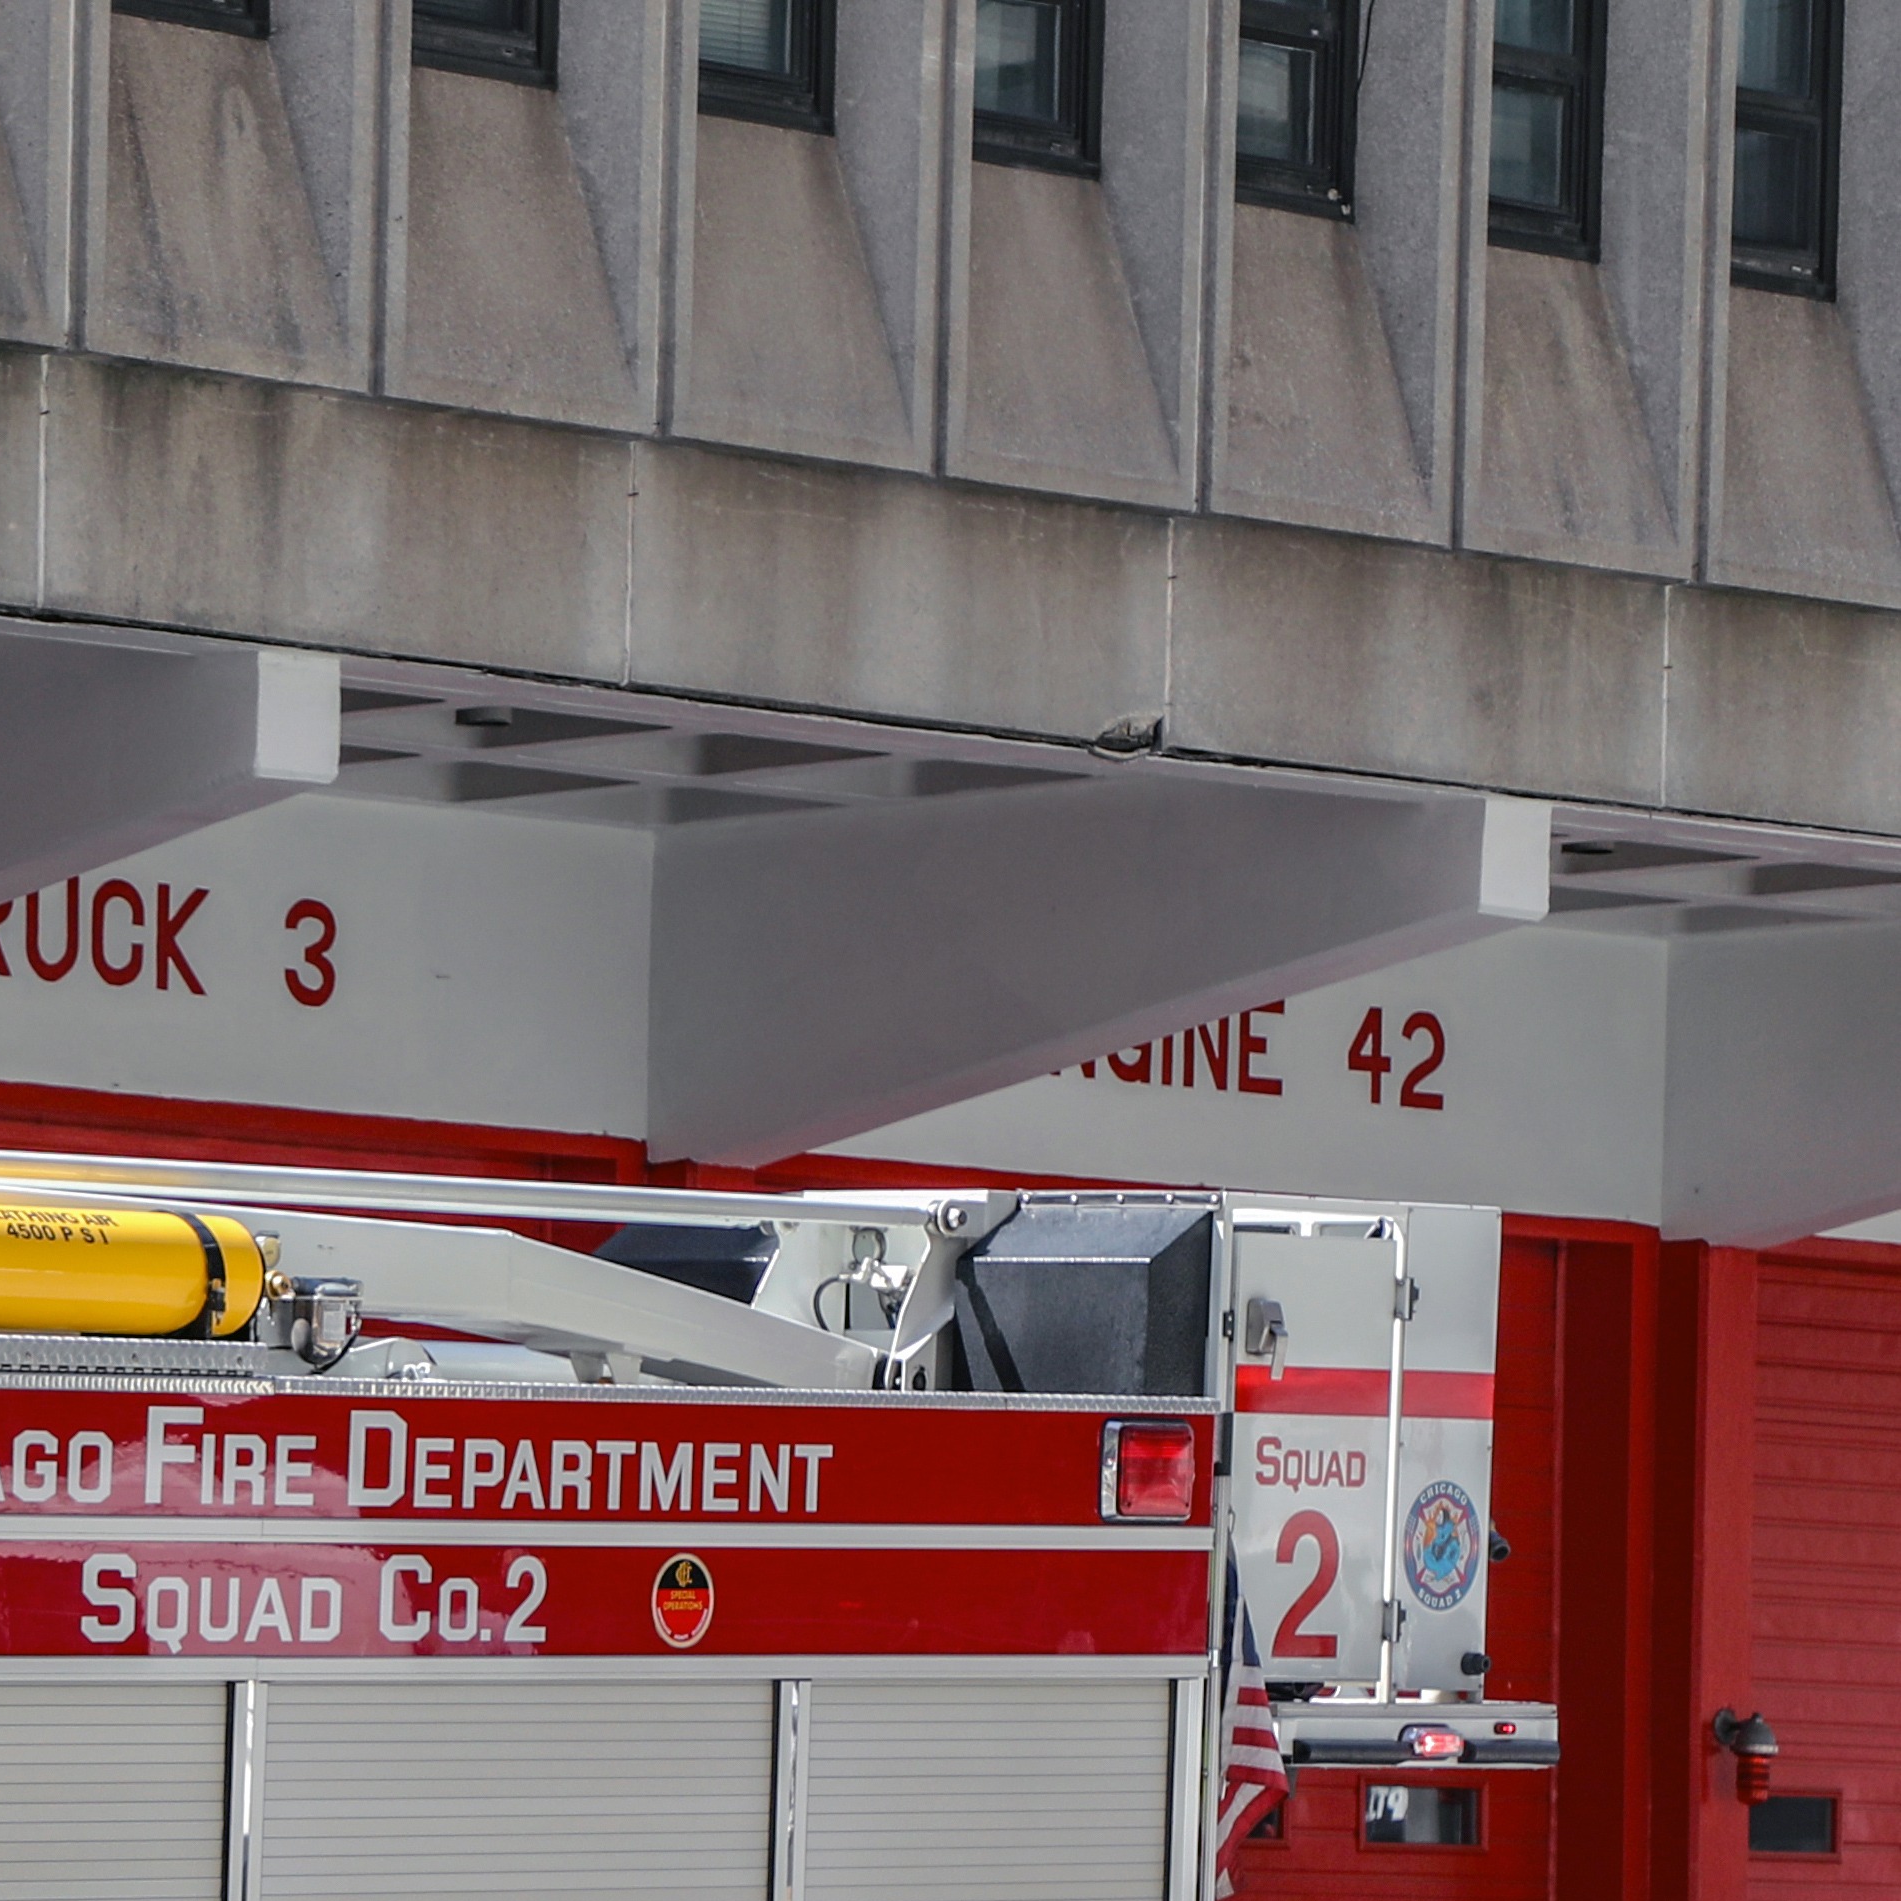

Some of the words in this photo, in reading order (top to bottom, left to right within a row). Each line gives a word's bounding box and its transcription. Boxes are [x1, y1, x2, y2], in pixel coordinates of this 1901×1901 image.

[283, 898, 337, 1007] 3
[1347, 1006, 1446, 1110] 42
[7, 1222, 57, 1241] 4500
[80, 1213, 120, 1228] AIR
[145, 1405, 318, 1507] FIRE
[347, 1409, 834, 1514] DEPARTMENT
[1255, 1436, 1367, 1493] SQUAD
[1419, 1483, 1468, 1505] CHICAGO
[80, 1552, 342, 1654] SQUAD
[1271, 1509, 1341, 1660] 2
[1417, 1587, 1453, 1608] SQUAD
